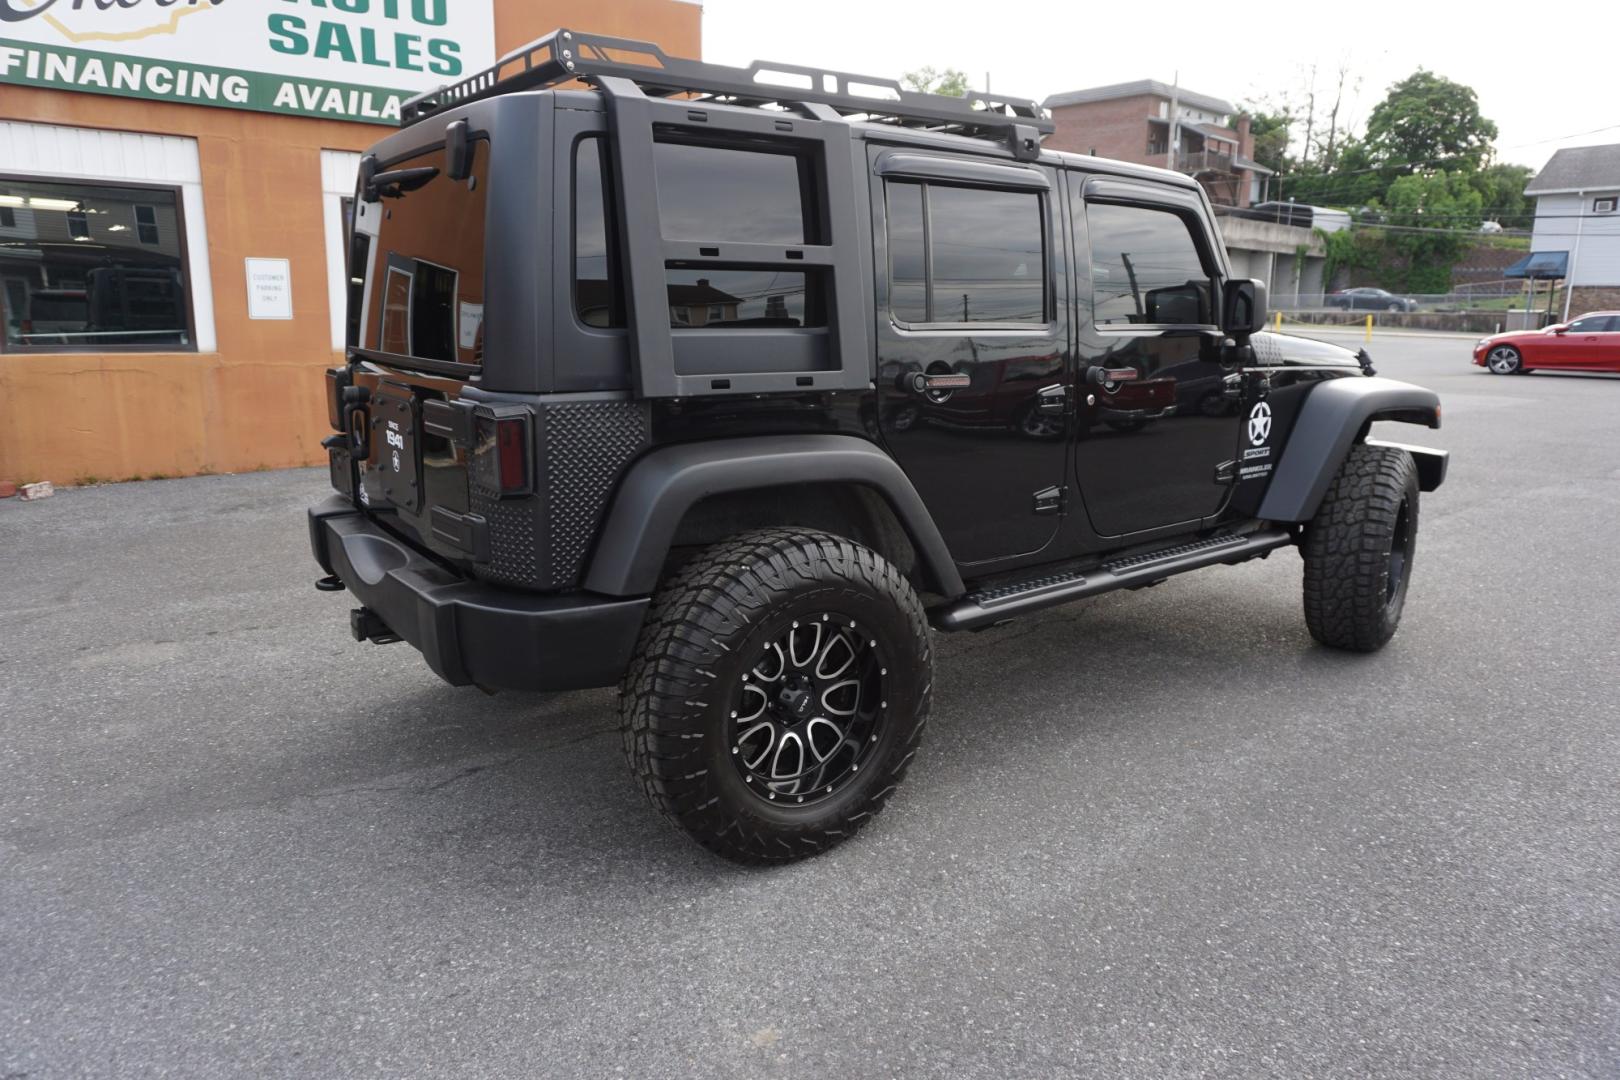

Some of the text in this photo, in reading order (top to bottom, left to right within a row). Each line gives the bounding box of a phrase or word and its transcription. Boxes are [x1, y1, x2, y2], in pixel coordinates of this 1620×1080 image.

[267, 13, 462, 76] SALES
[0, 46, 401, 120] FINANCING AVAILA
[386, 430, 404, 450] 1941
[1245, 449, 1269, 457] SPORT
